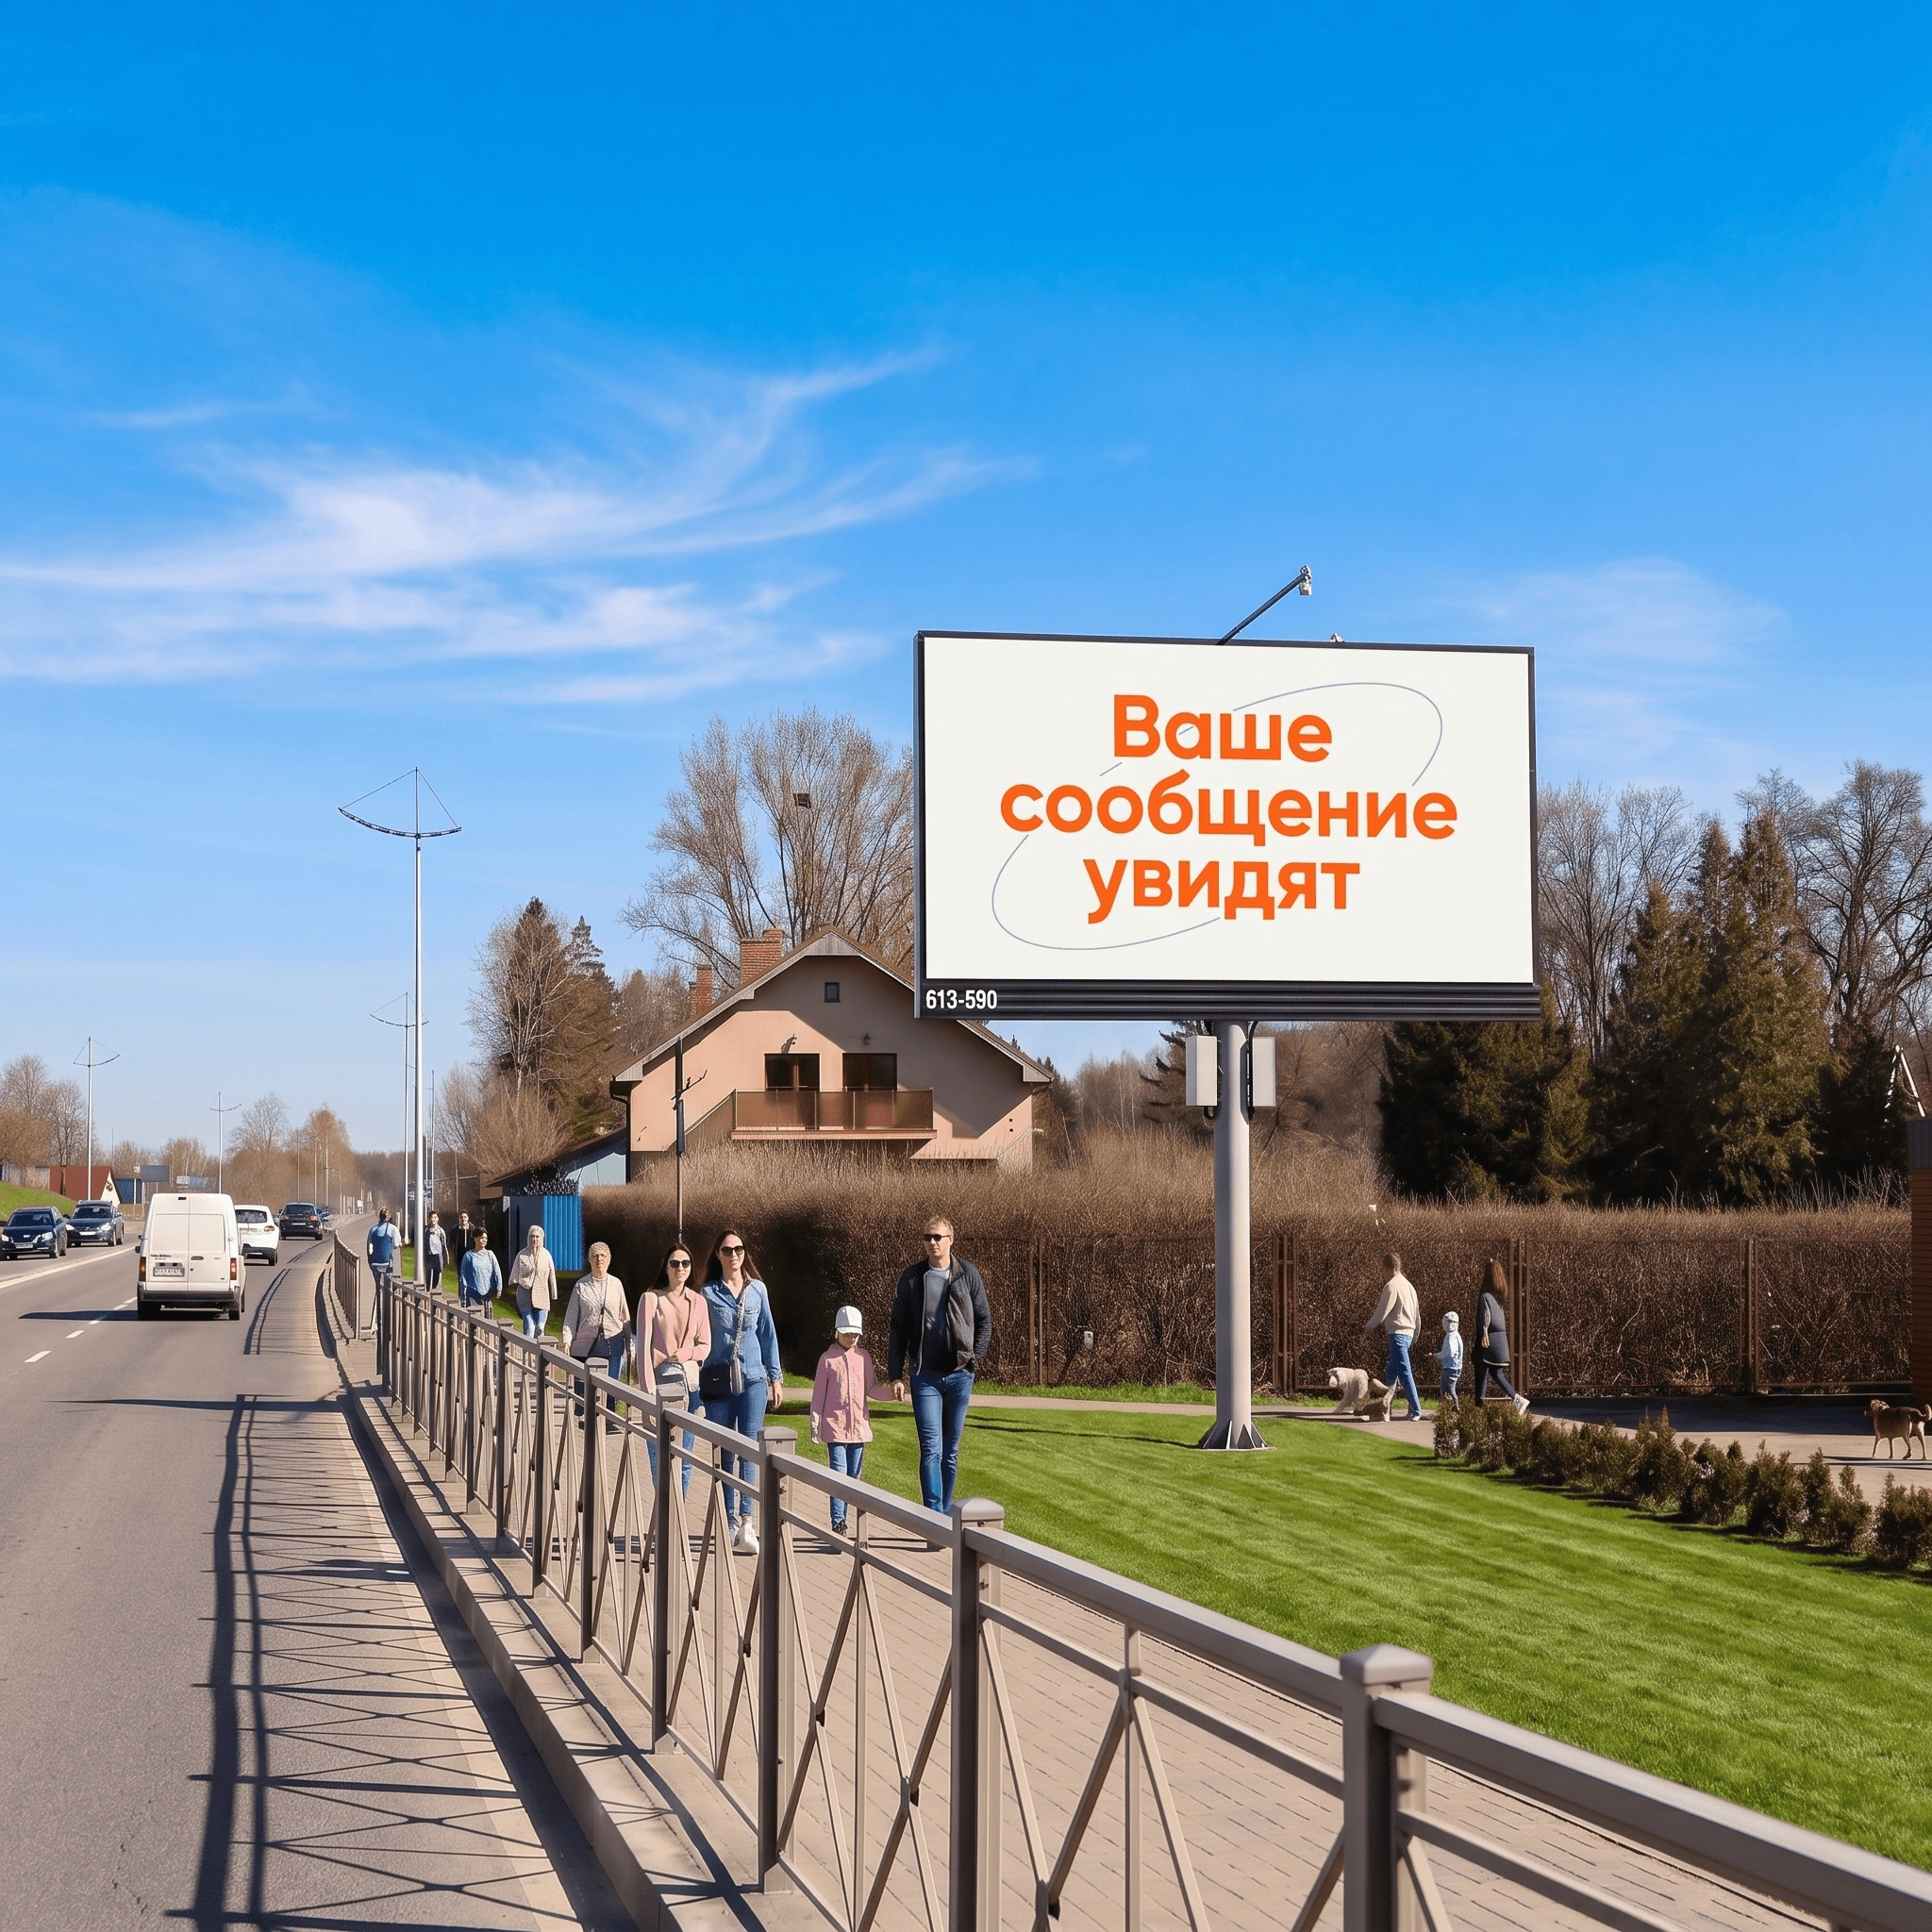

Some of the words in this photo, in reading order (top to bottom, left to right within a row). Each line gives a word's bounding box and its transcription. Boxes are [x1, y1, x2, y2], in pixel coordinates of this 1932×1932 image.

[1113, 693, 1333, 763] Ваше
[1000, 769, 1457, 847] сообщение
[1082, 858, 1360, 924] увидят
[925, 989, 998, 1009] 613-590
